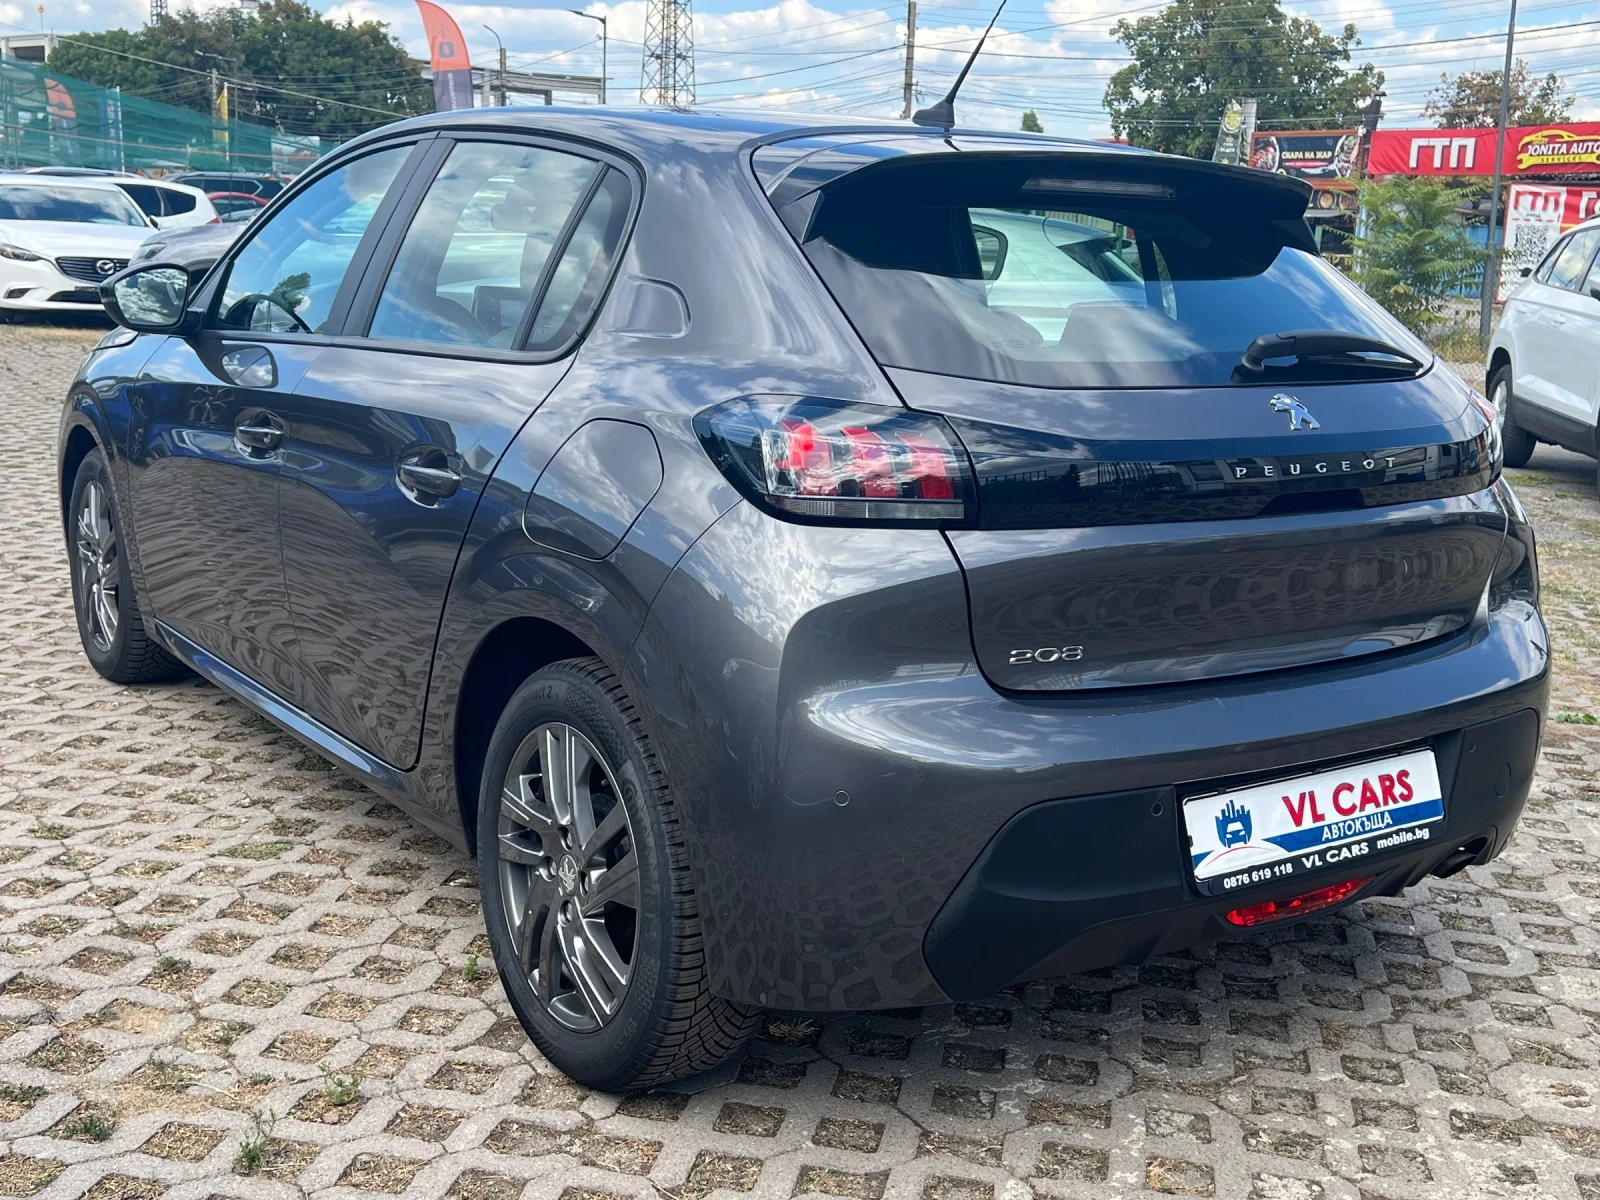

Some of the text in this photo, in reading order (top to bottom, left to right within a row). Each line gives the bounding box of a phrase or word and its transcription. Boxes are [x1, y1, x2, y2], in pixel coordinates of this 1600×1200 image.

[1281, 150, 1333, 159] СКАРА НА ЖАР
[1409, 137, 1476, 168] ГТП
[1569, 141, 1600, 154] AUTO
[1513, 190, 1561, 212] ГТП
[1235, 457, 1395, 478] PEUGEOT
[1009, 646, 1083, 665] 208
[1282, 769, 1413, 827] VL CARS
[1322, 811, 1393, 841] АВТОКЪЩА
[1224, 827, 1430, 889] 0876 619 118 VL CARS mobile.bg
